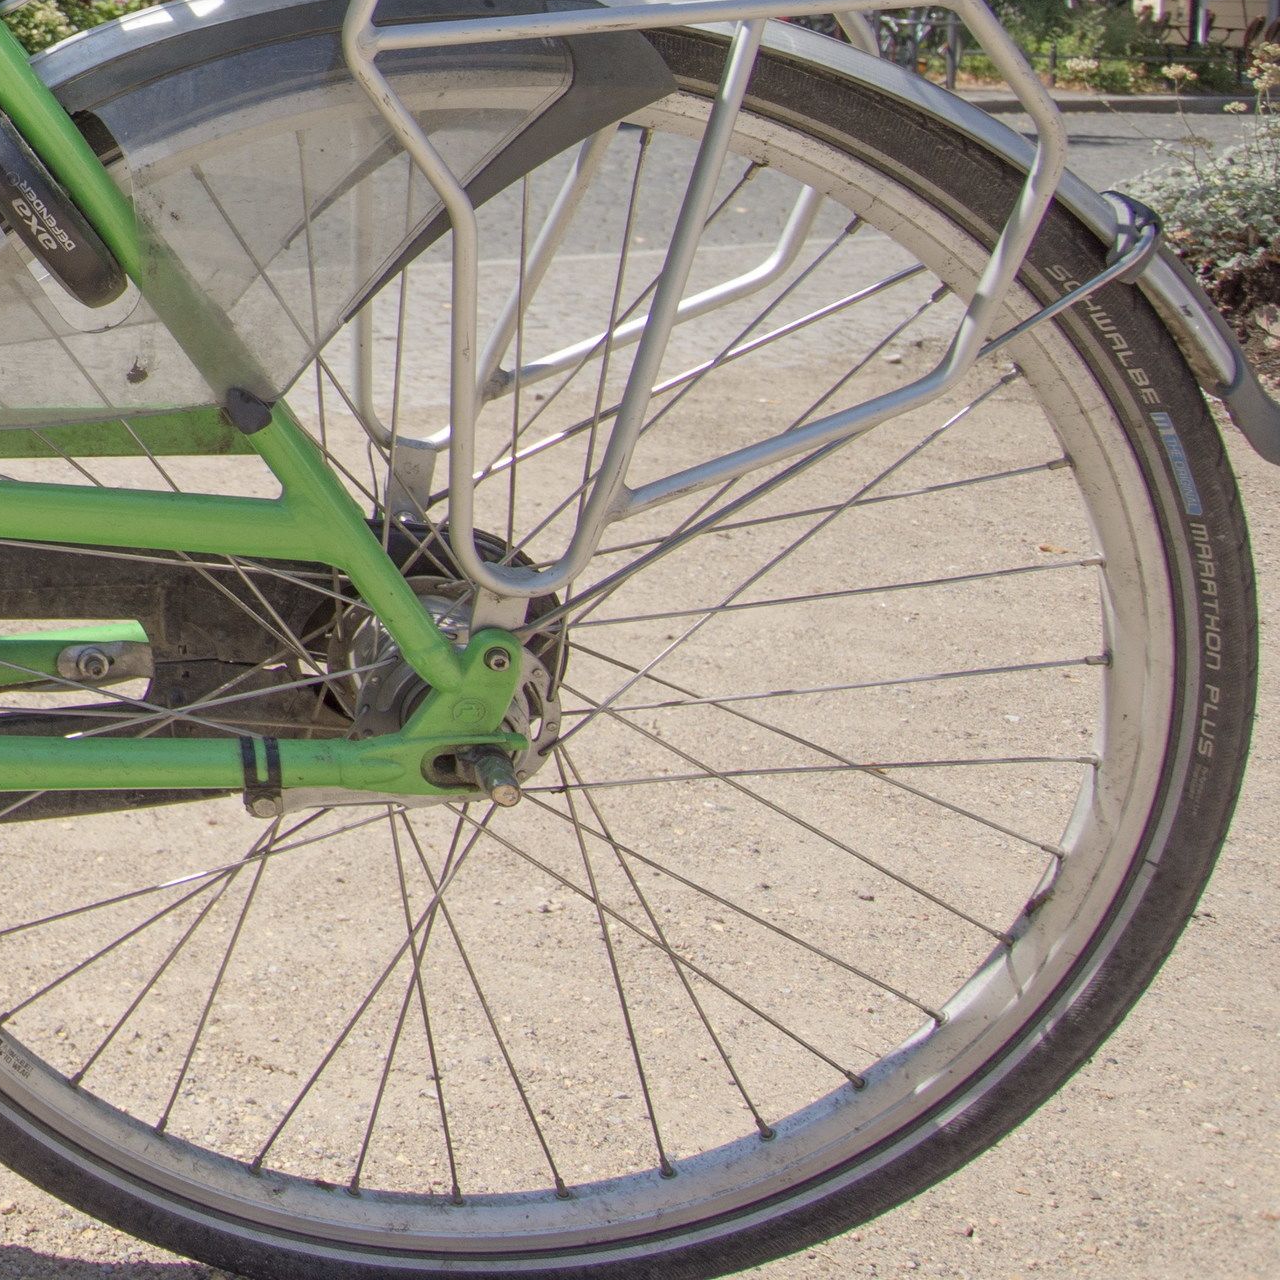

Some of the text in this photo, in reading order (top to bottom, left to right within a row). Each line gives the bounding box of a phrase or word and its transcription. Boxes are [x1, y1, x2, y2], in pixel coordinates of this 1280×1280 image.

[20, 180, 76, 252] DEFENDER
[1189, 521, 1222, 671] MARATHON
[1196, 683, 1223, 754] PLUS
